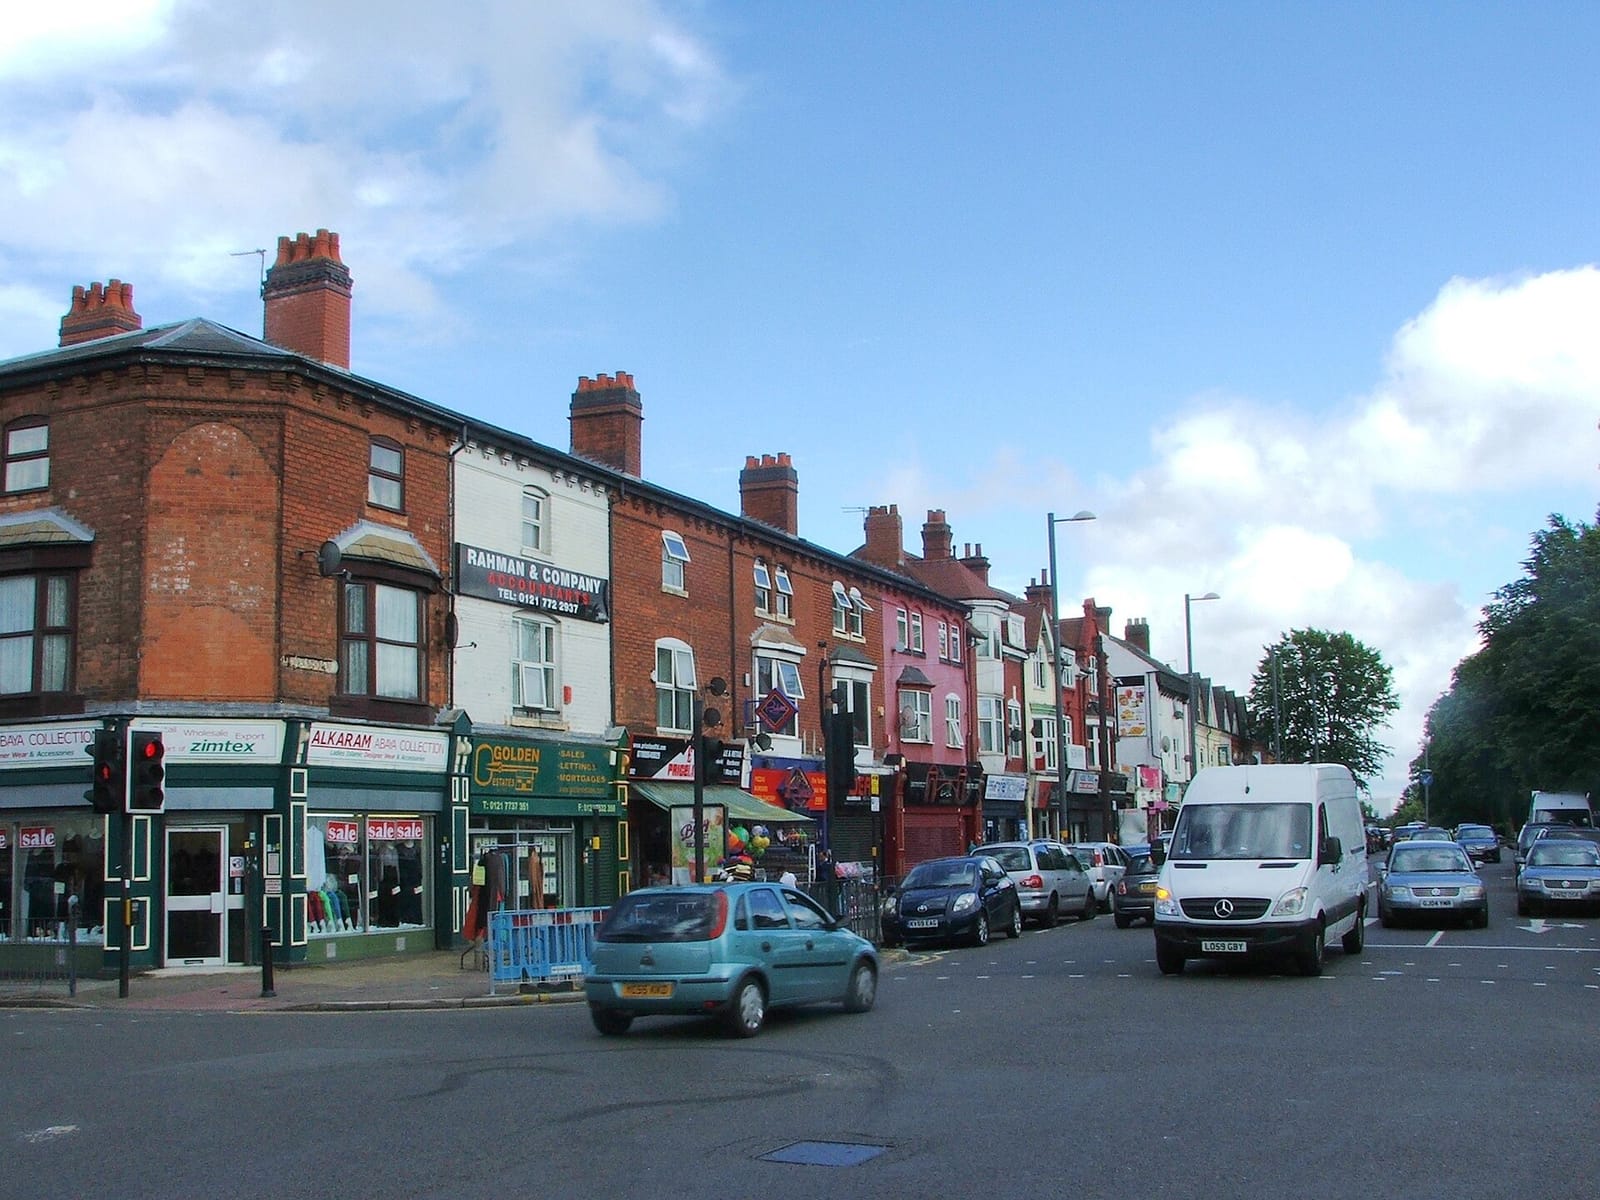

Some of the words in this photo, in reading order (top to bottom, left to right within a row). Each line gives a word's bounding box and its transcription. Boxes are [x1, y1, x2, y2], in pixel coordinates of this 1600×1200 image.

[468, 549, 525, 577] RAHMAN
[529, 564, 539, 580] &
[542, 568, 601, 594] COMPANY
[488, 573, 591, 605] ACCOUNTANTS
[498, 588, 517, 601] TEL:
[518, 594, 539, 607] 0121
[542, 597, 558, 610] 772
[183, 729, 229, 737] Wholesale
[235, 732, 265, 741] Export
[312, 730, 373, 748] ALKARAM
[400, 739, 445, 754] COLLECTION
[190, 739, 256, 753] zimtex
[493, 746, 540, 762] GOLDEN
[559, 775, 606, 784] MORTGAGES
[22, 829, 55, 846] sale
[328, 826, 356, 842] sale
[368, 824, 395, 839] sale
[396, 824, 422, 839] sale
